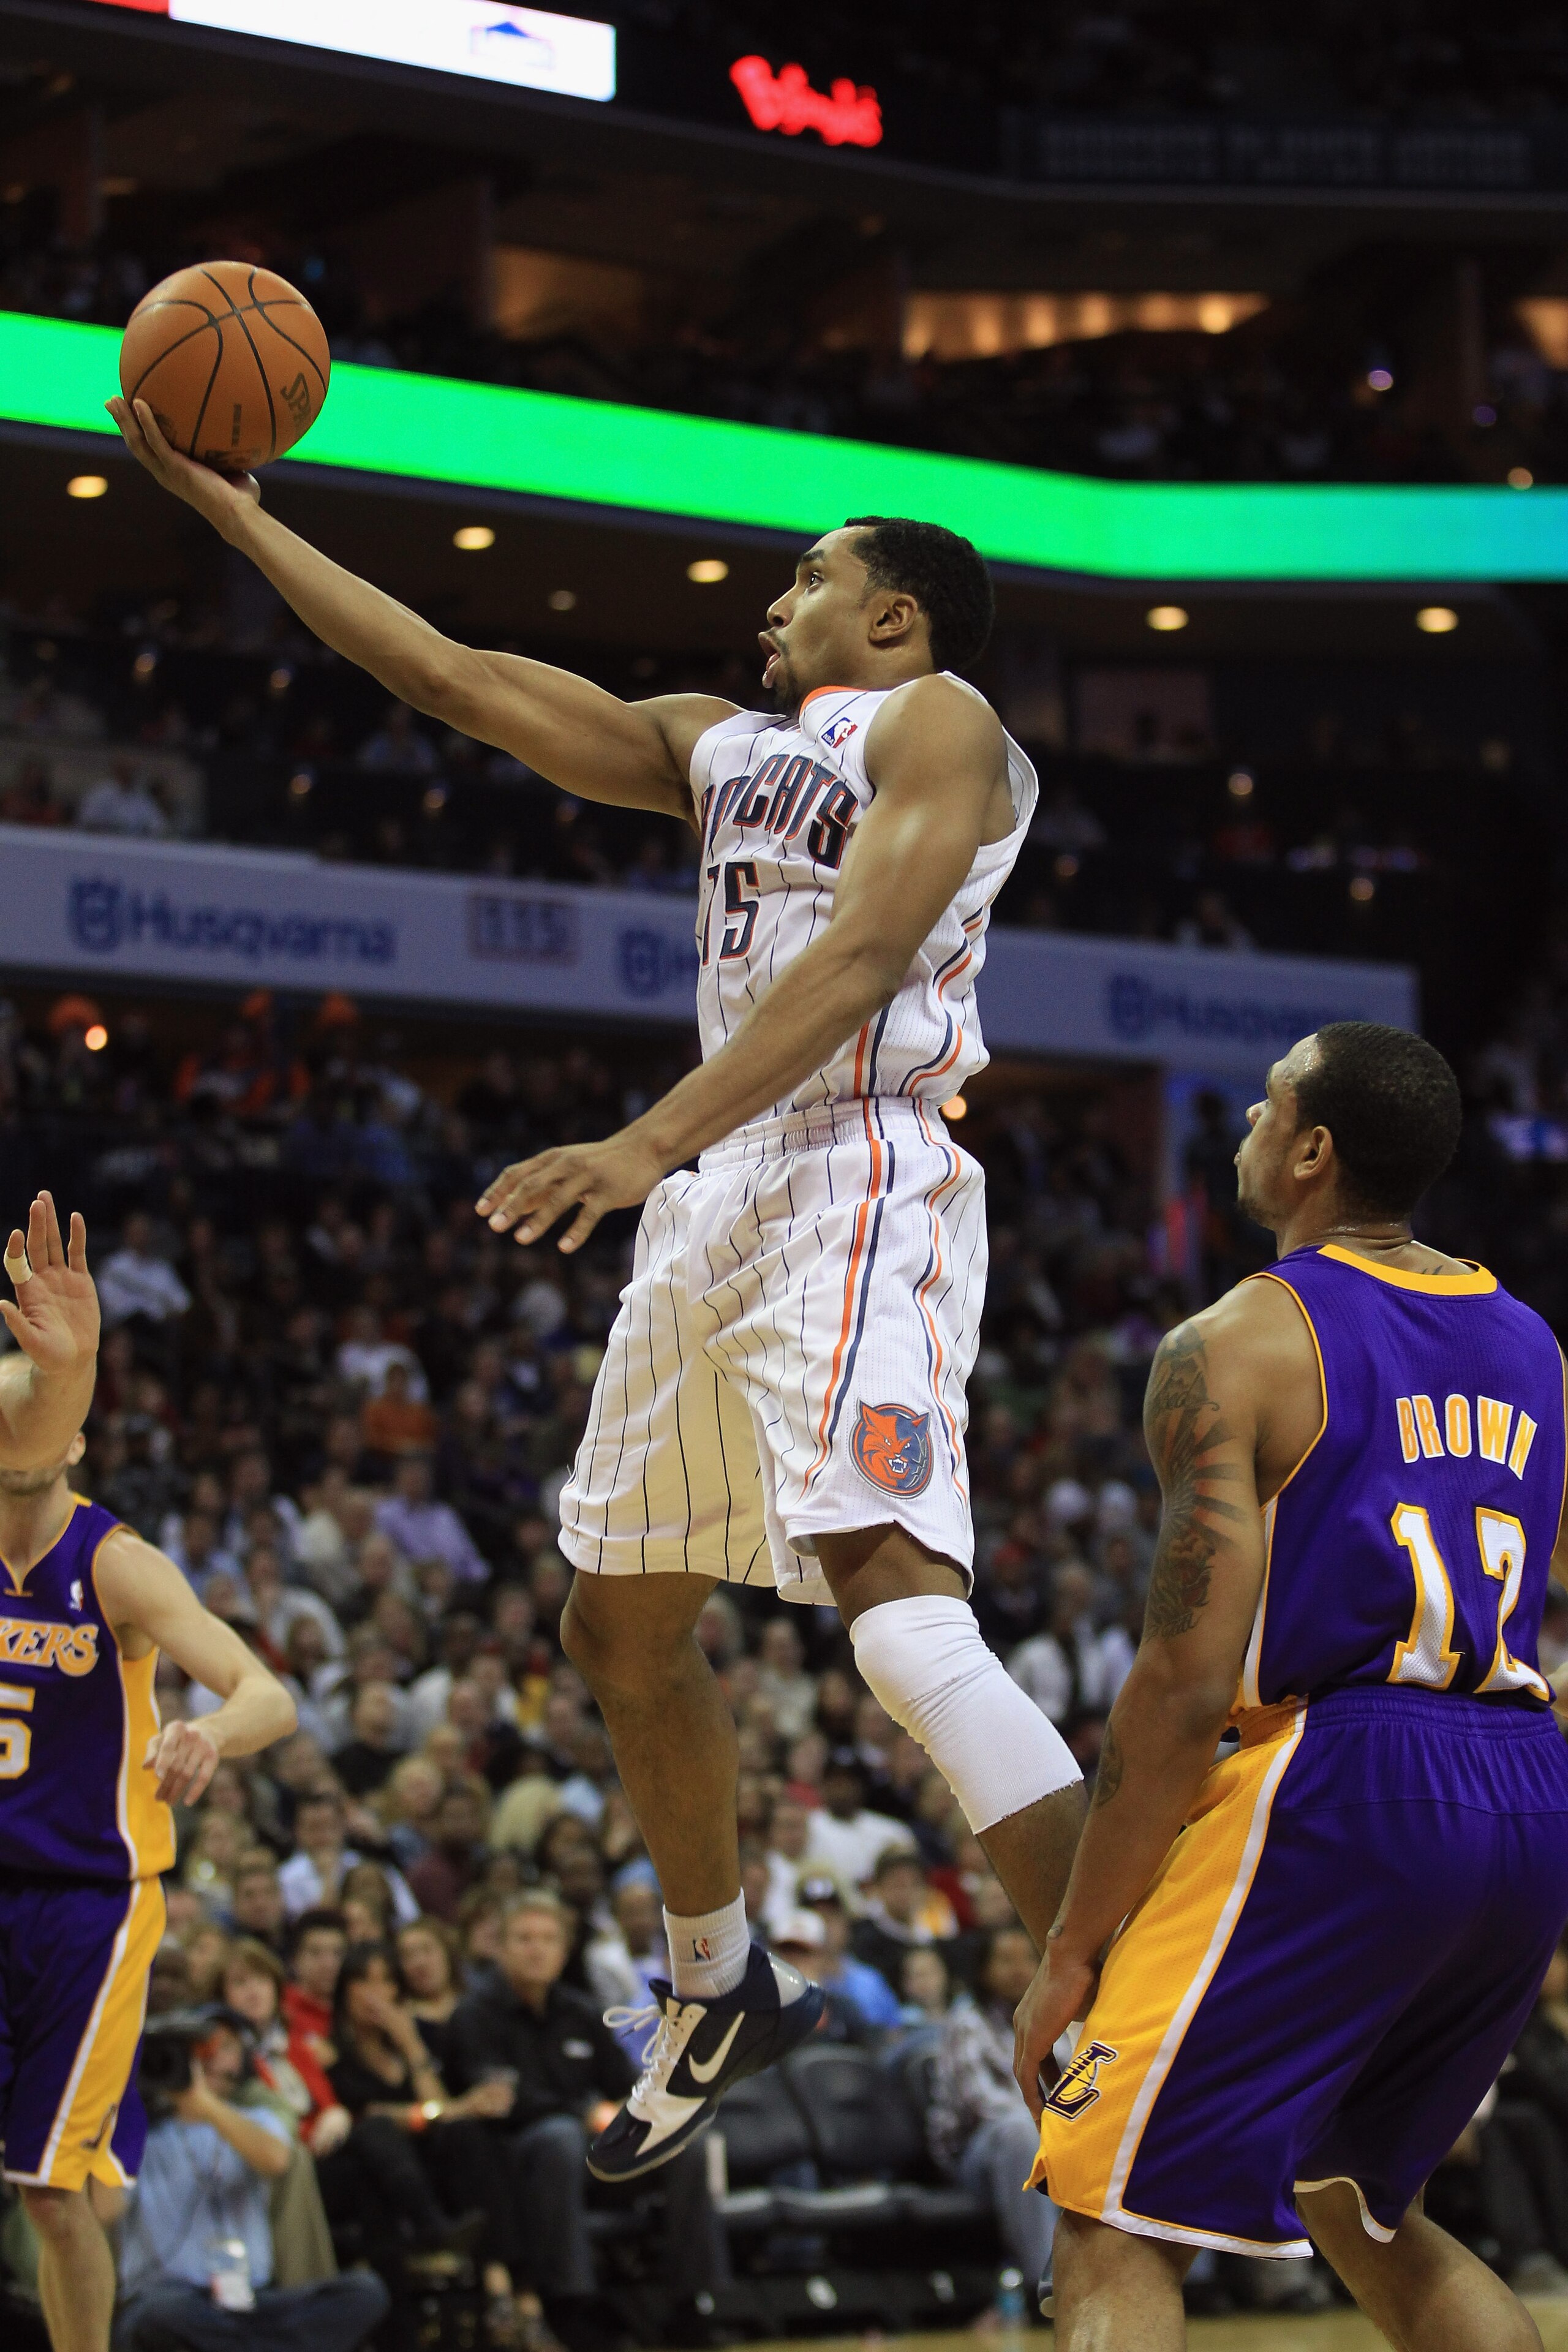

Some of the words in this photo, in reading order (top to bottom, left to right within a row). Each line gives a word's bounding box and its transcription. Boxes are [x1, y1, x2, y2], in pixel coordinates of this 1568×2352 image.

[128, 890, 397, 966] Husqvarna
[1396, 1393, 1538, 1480] BROWN
[1385, 1502, 1549, 1702] 12
